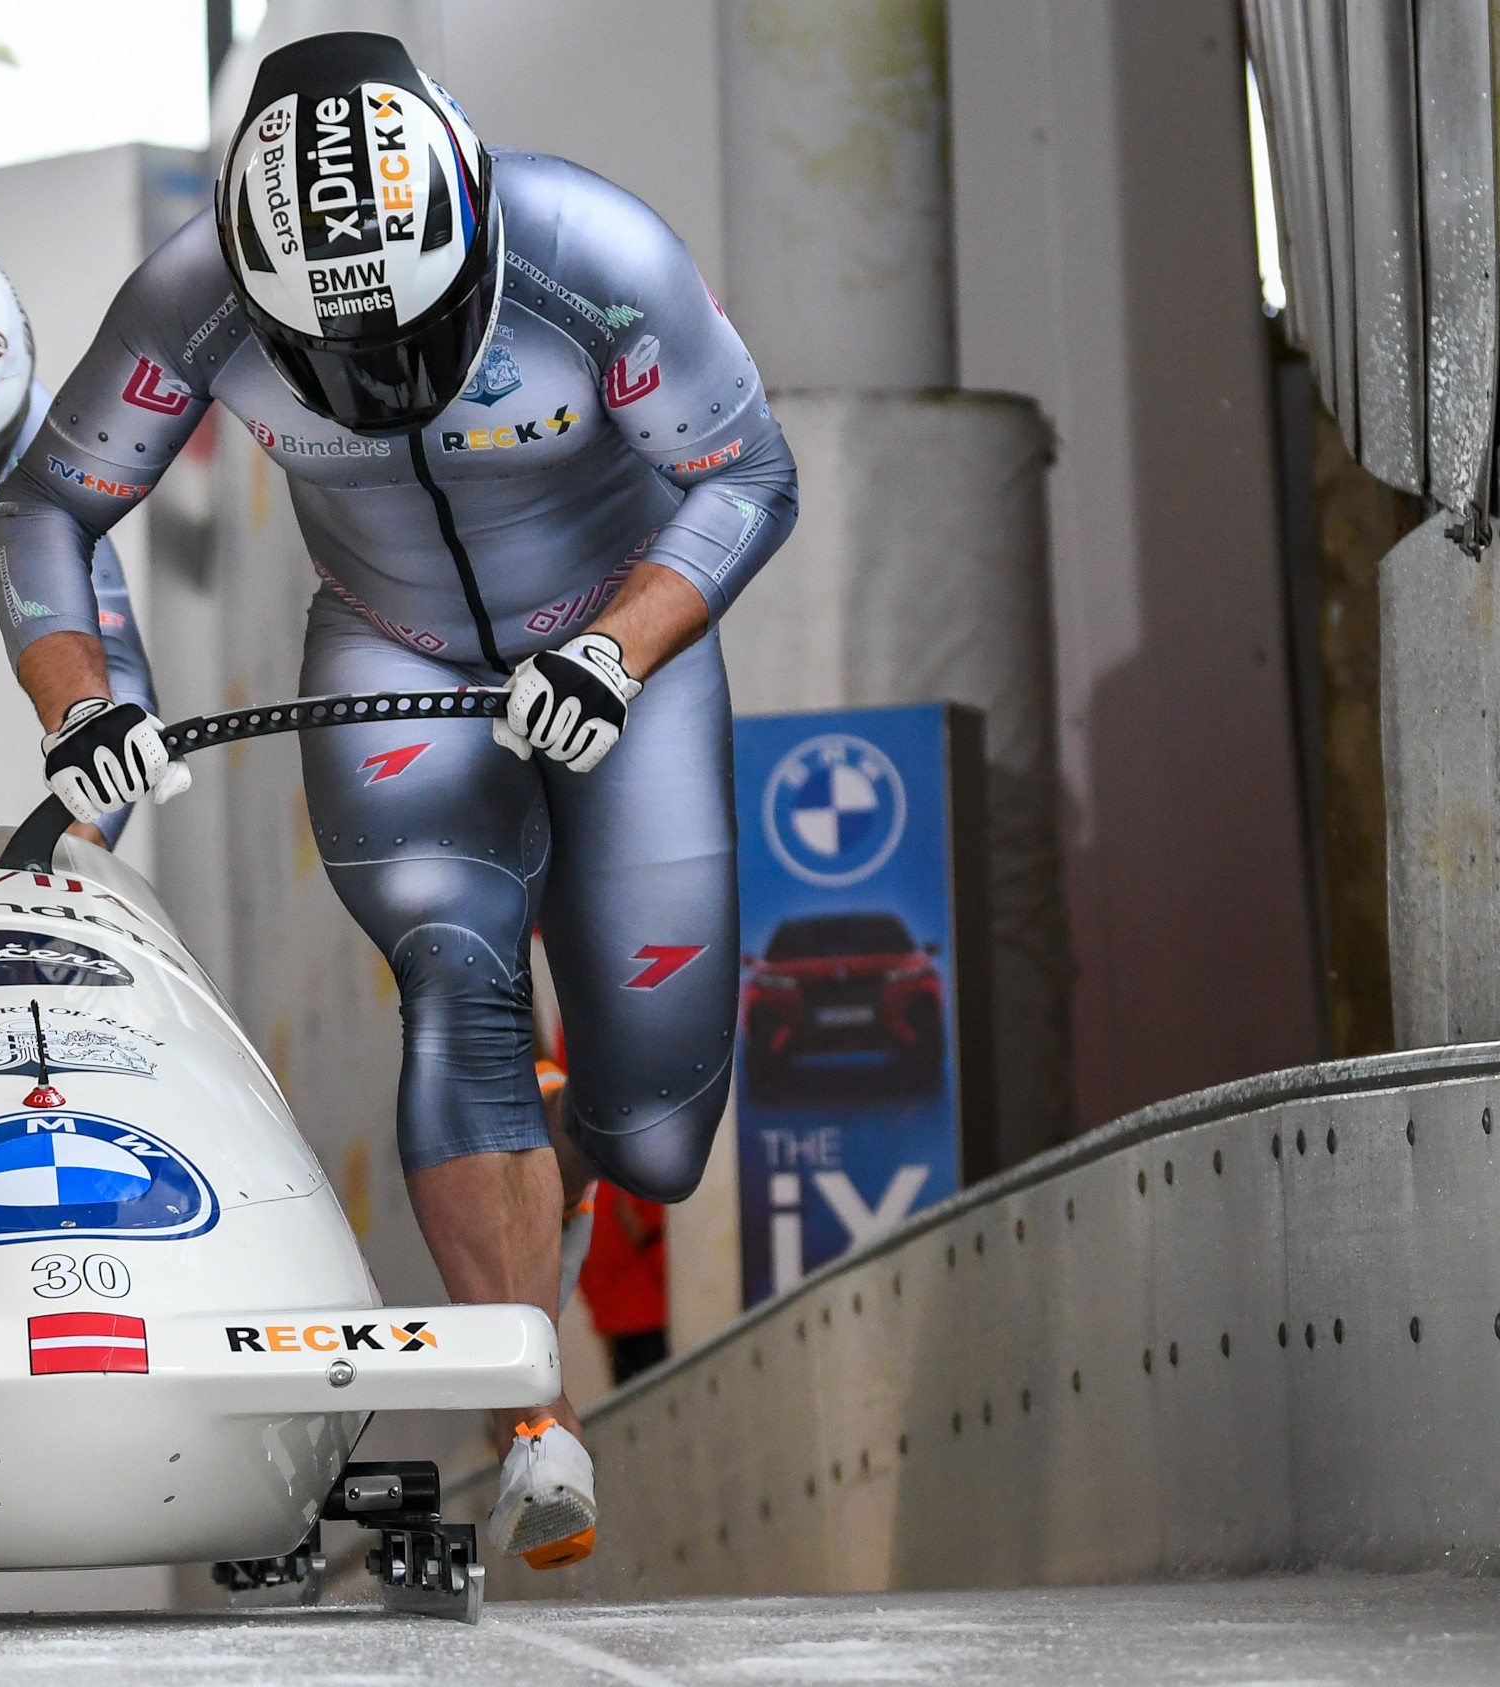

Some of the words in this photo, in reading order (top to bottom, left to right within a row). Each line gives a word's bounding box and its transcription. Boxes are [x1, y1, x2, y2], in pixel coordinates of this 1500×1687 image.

[306, 96, 364, 244] xDrive
[262, 144, 299, 257] Binders
[307, 259, 388, 295] BMW
[315, 291, 394, 319] helmets
[280, 432, 392, 459] Binders
[48, 1007, 91, 1018] OF
[97, 1016, 167, 1047] RIGA
[30, 1253, 131, 1299] 30
